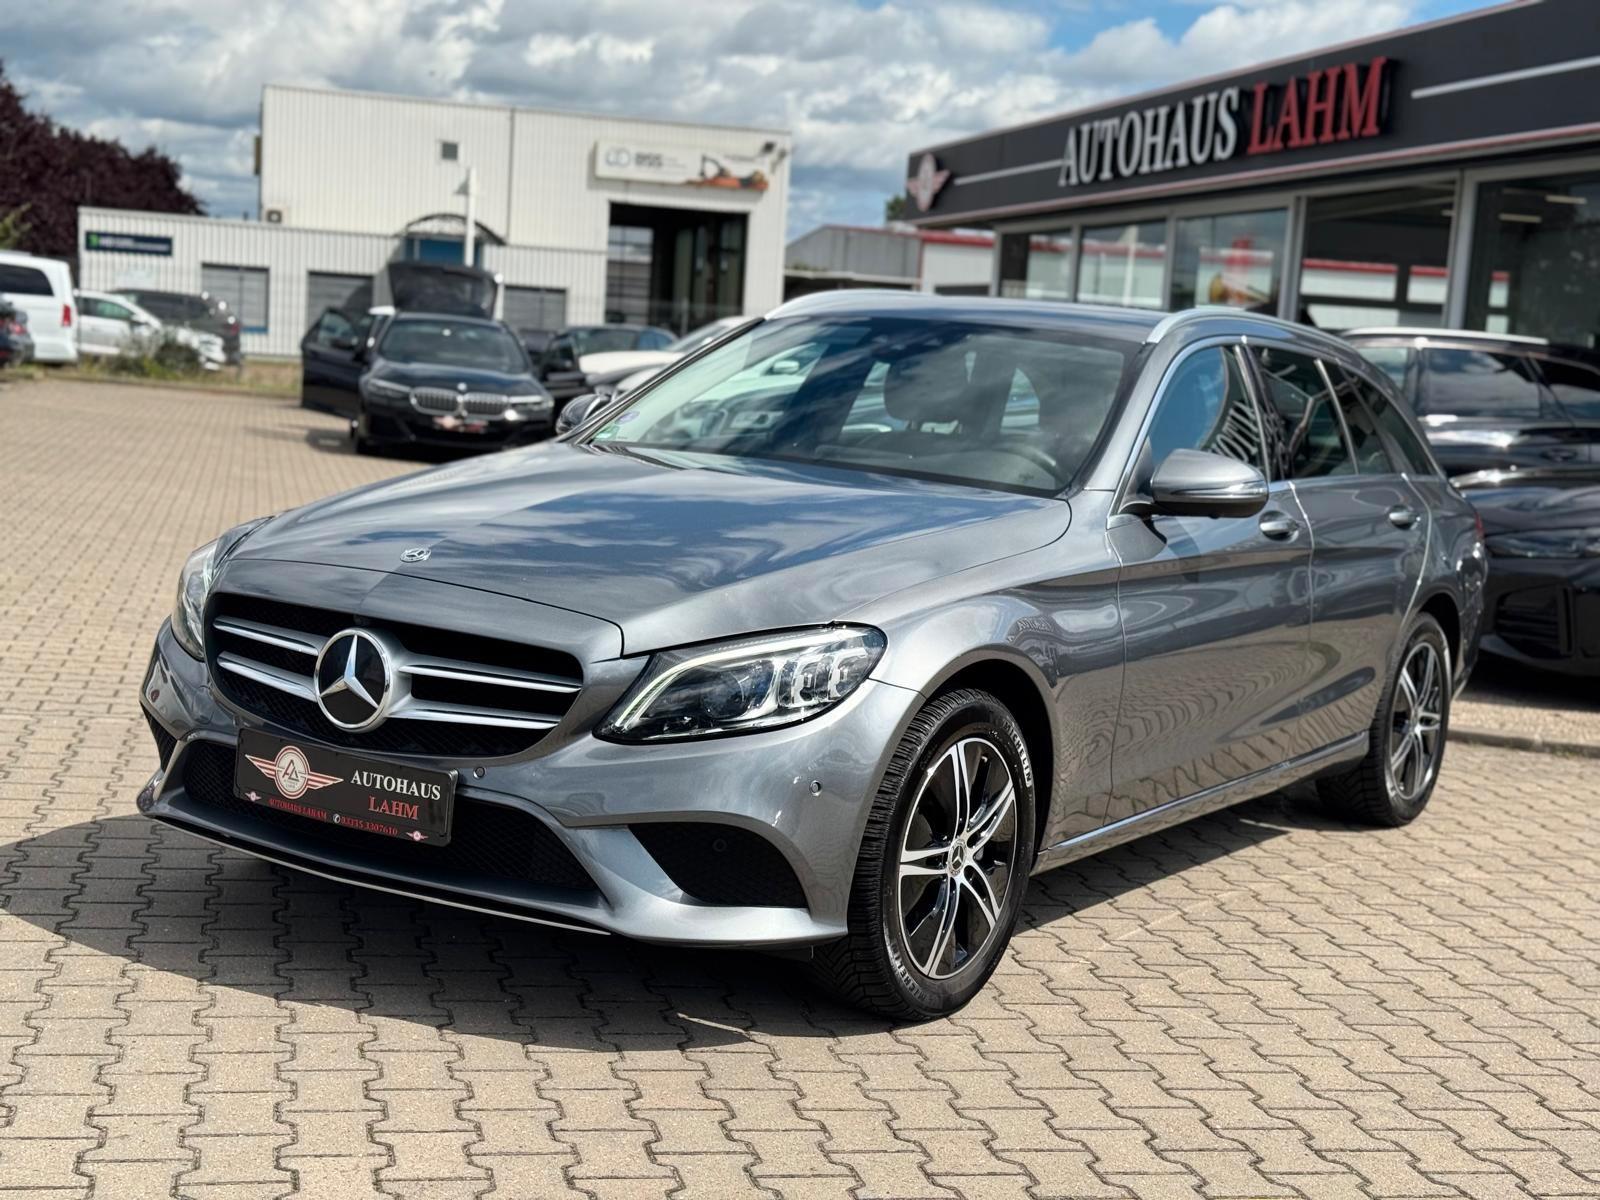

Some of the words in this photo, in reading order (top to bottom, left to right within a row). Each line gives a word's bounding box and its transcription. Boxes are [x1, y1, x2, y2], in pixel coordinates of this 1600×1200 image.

[1058, 87, 1239, 186] AUTOHAUS
[1247, 56, 1387, 154] LAHM
[1002, 721, 1033, 784] MICHELIN
[350, 769, 441, 800] AUTOHAUS
[367, 795, 418, 820] LAHM
